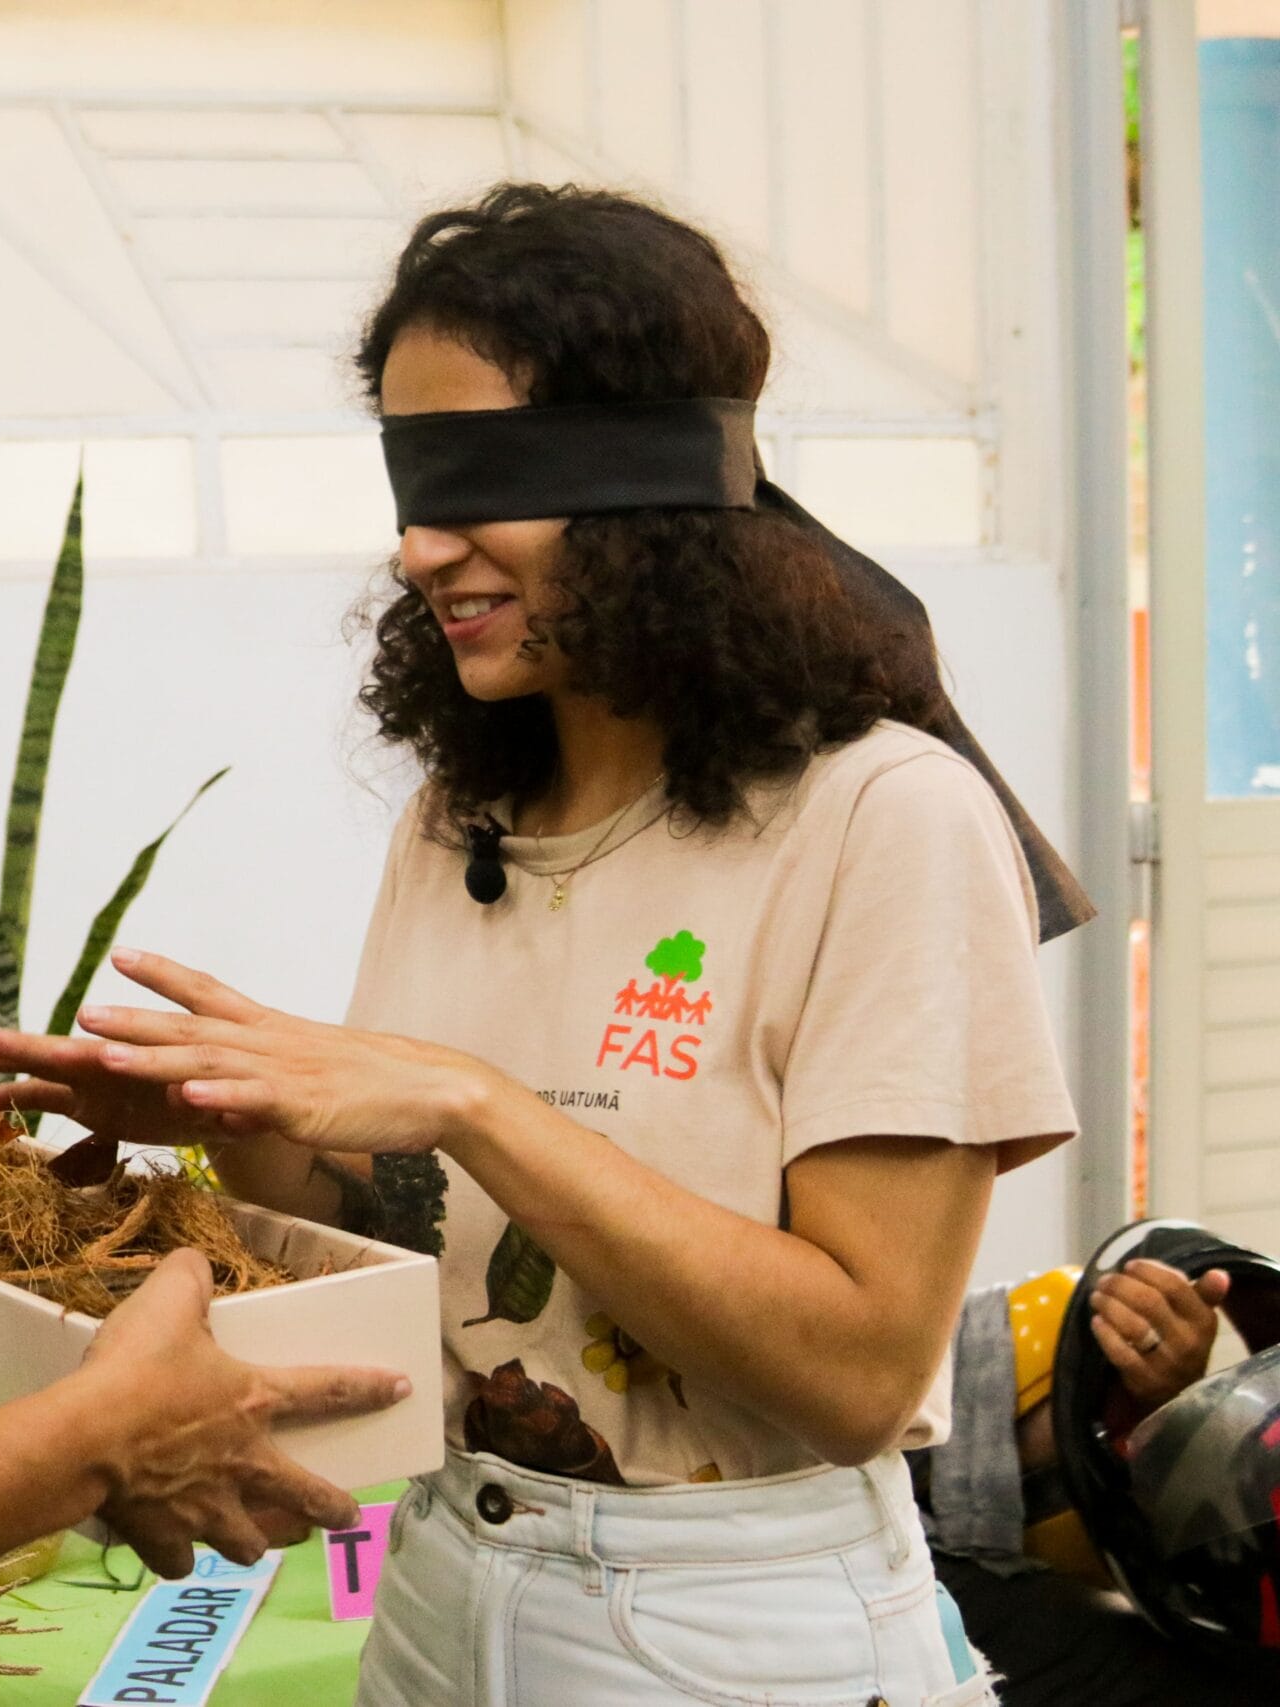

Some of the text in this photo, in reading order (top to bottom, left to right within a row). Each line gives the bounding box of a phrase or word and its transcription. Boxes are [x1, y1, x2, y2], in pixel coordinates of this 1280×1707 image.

[596, 1023, 702, 1081] FAS
[559, 1089, 620, 1111] UATUMÃ
[113, 1587, 242, 1703] PALADAR
